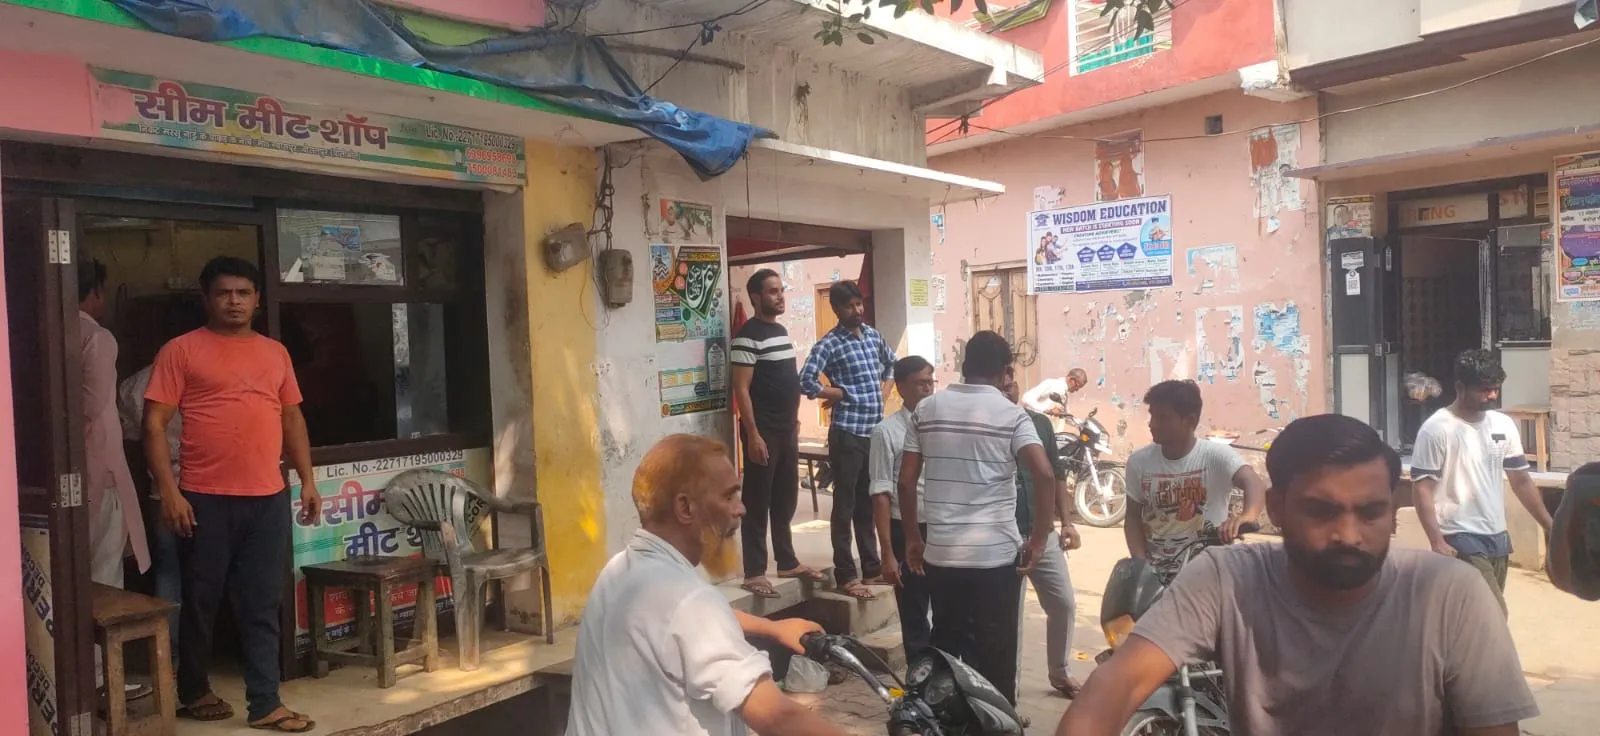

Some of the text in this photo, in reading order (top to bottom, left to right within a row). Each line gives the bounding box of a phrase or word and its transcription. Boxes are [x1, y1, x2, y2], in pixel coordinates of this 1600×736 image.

[130, 82, 225, 127] सीम
[236, 97, 311, 139] मीट
[319, 113, 388, 150] शॉप
[1053, 200, 1167, 225] WISDOM EDUCATION
[326, 466, 349, 478] Lic.
[344, 521, 400, 557] मीट
